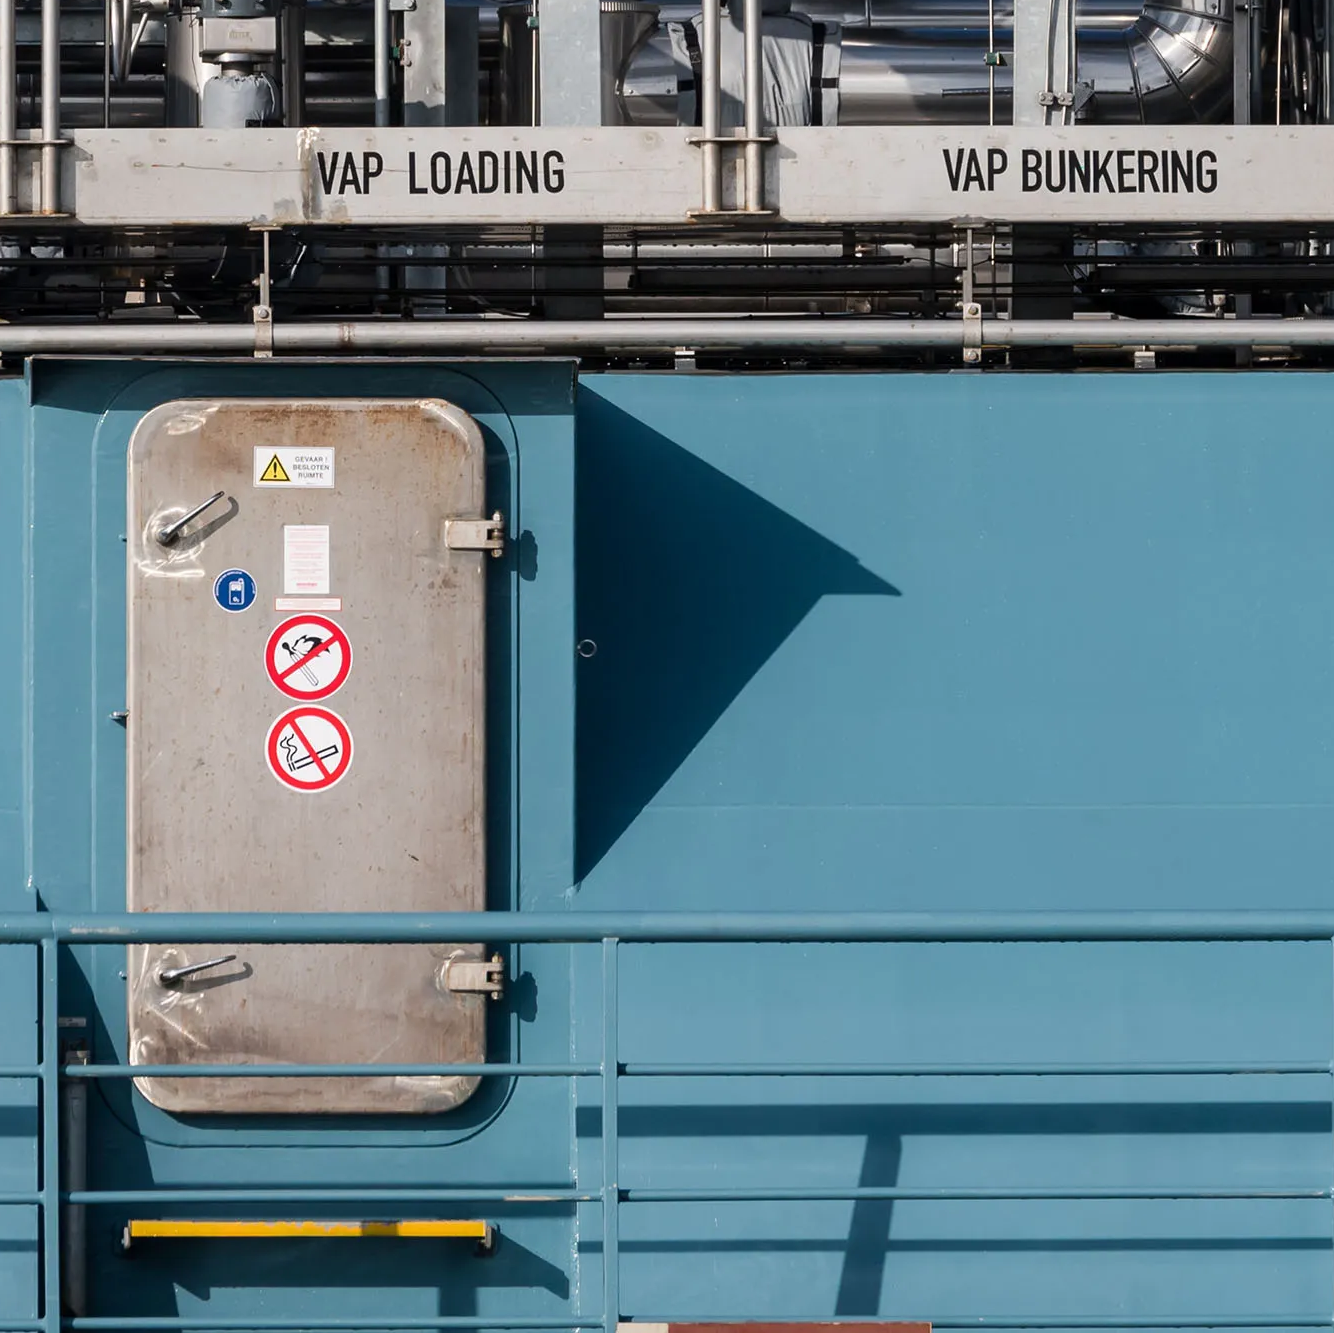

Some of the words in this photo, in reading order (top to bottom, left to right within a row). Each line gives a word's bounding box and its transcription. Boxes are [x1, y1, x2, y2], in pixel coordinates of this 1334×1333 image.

[317, 150, 383, 195] VAP
[409, 150, 565, 195] LOADING
[943, 148, 1008, 193] VAP
[1022, 149, 1218, 194] BUNKERING
